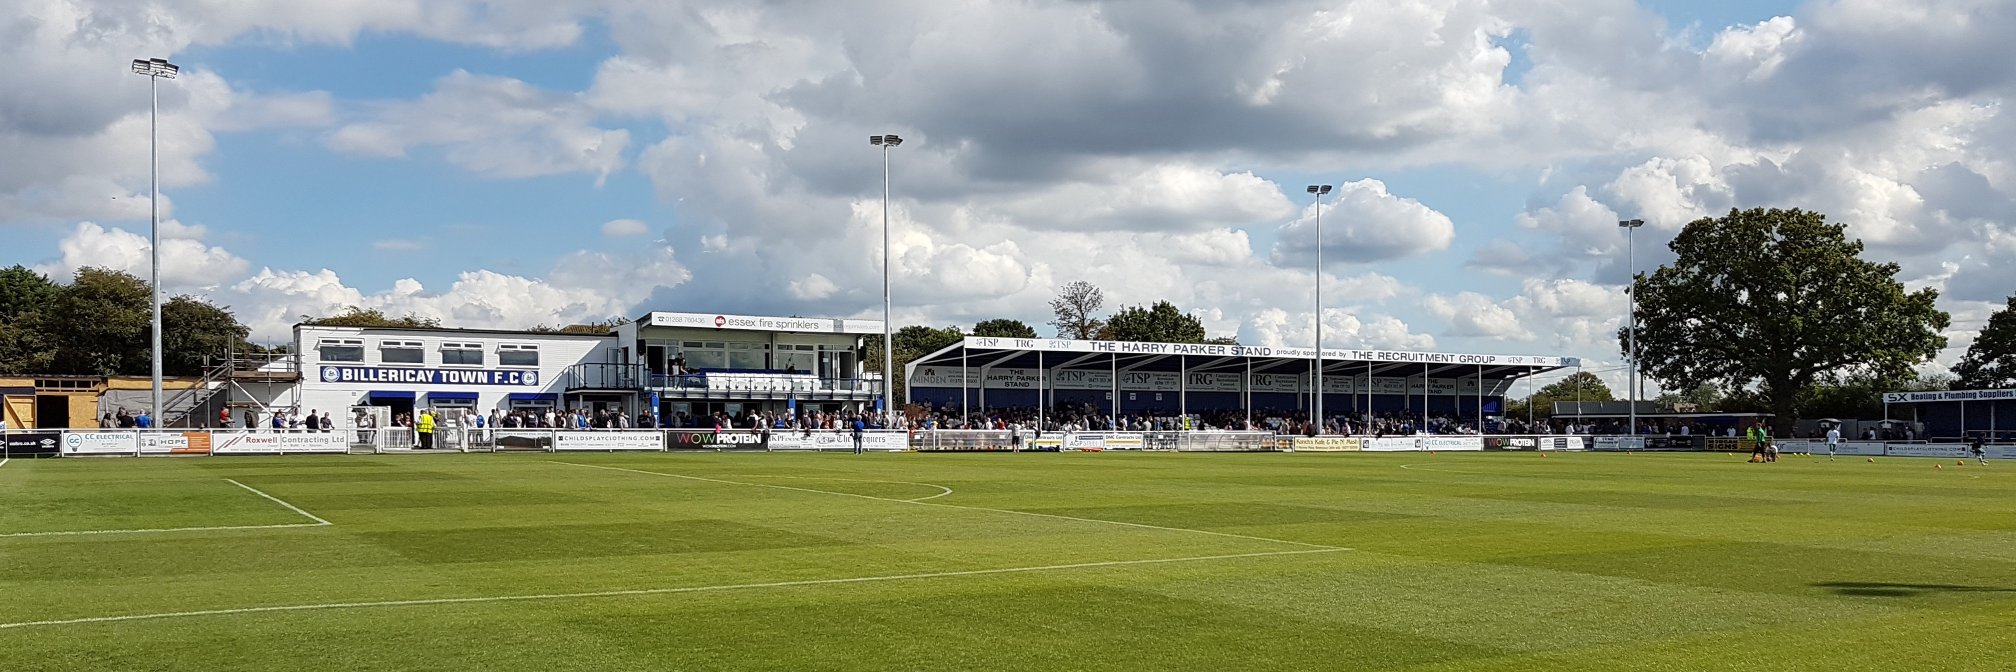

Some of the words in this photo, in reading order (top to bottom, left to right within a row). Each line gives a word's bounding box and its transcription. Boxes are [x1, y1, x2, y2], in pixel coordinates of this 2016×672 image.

[759, 318, 773, 328] fire
[775, 319, 818, 330] sprinklers
[982, 338, 999, 346] TSP
[1014, 340, 1033, 348] TRG
[1090, 342, 1115, 352] THE
[1122, 342, 1167, 353] HARRY
[1174, 344, 1225, 355] PARKER
[1231, 346, 1272, 356] STAND
[1352, 351, 1373, 359] THE
[1378, 352, 1455, 362] RECRUITMENT
[1459, 355, 1495, 364] GROUP
[342, 370, 435, 383] BILLERICAY
[439, 371, 487, 383] TOWN
[494, 372, 519, 384] F.C
[1064, 370, 1085, 382] TSP
[1129, 373, 1150, 383] TSP
[1189, 374, 1212, 385] TRG
[1250, 375, 1272, 386] TRG
[1888, 394, 1908, 402] SX
[677, 434, 715, 444] WOW
[717, 434, 761, 444] PROTEIN
[1488, 438, 1509, 446] WOW
